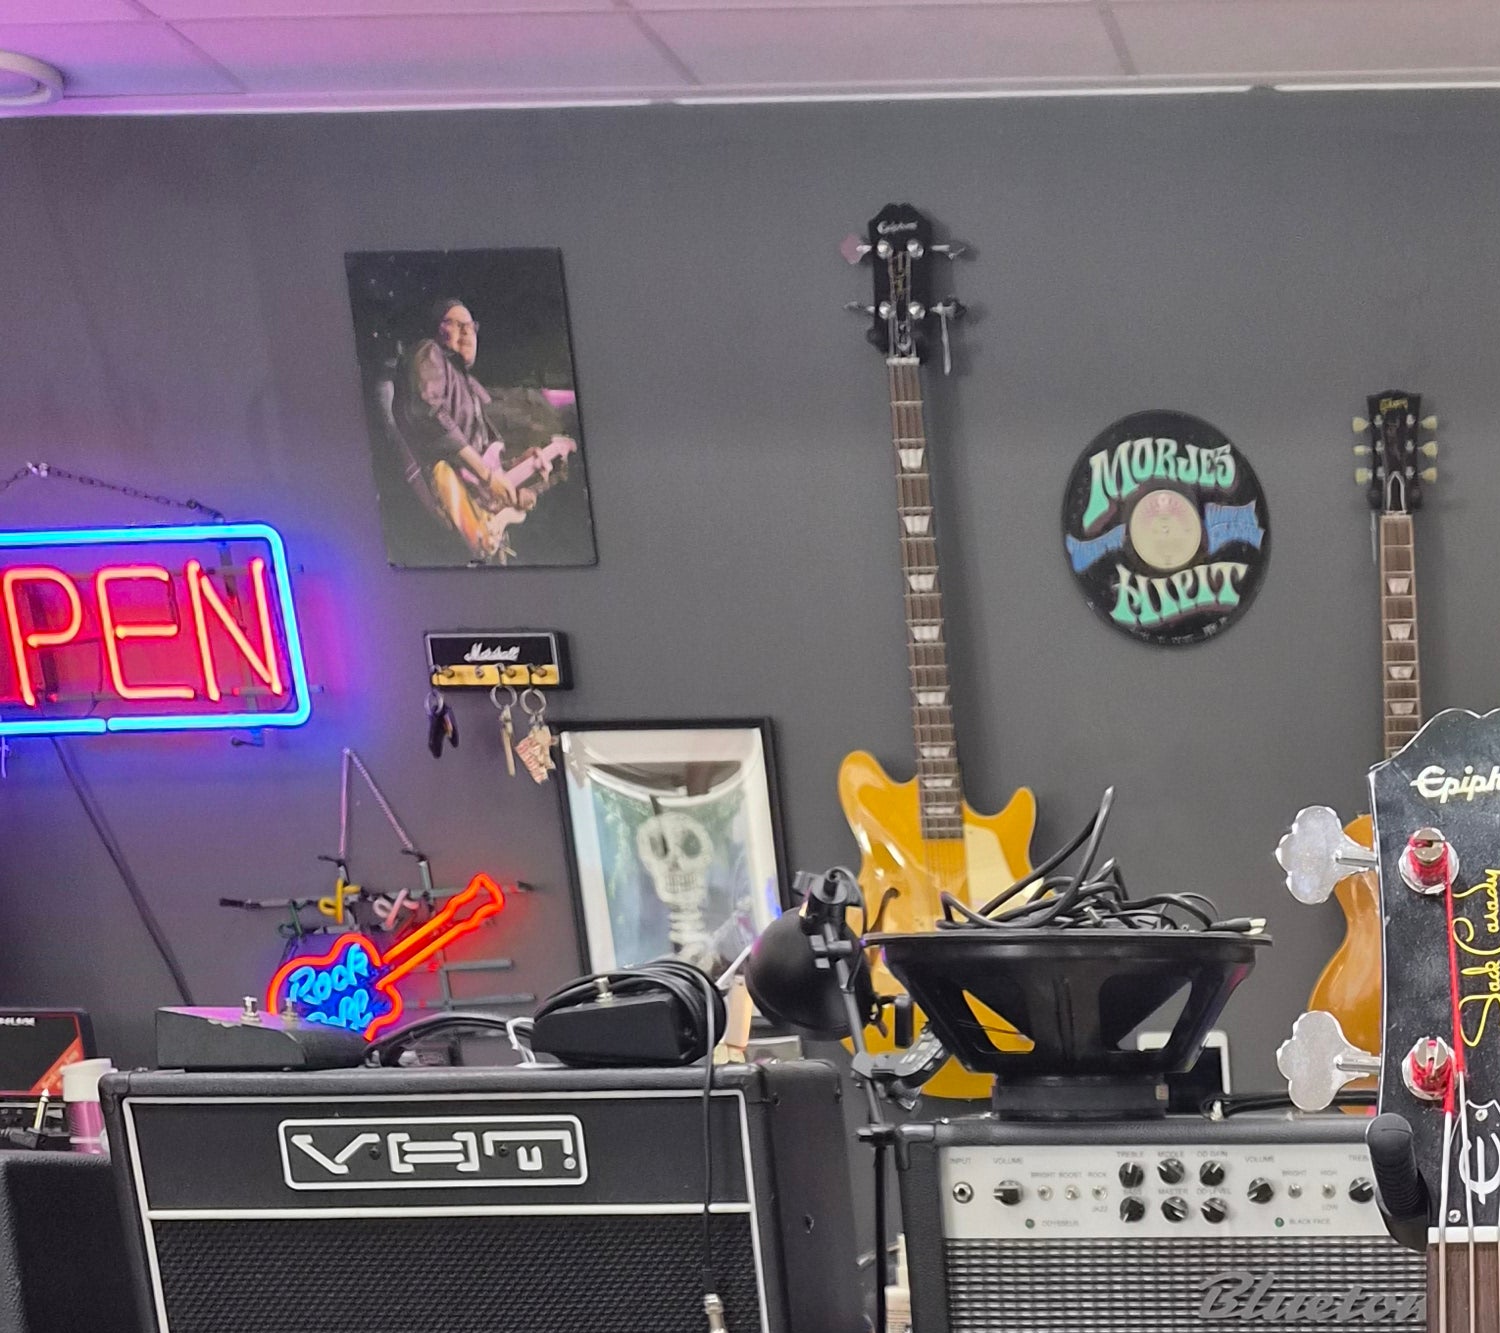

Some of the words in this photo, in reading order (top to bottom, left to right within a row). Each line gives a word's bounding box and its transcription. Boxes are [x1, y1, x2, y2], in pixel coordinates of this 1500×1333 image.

[1083, 437, 1236, 529] MORJES
[3, 559, 283, 706] PEN
[1198, 1271, 1426, 1321] Blueton
